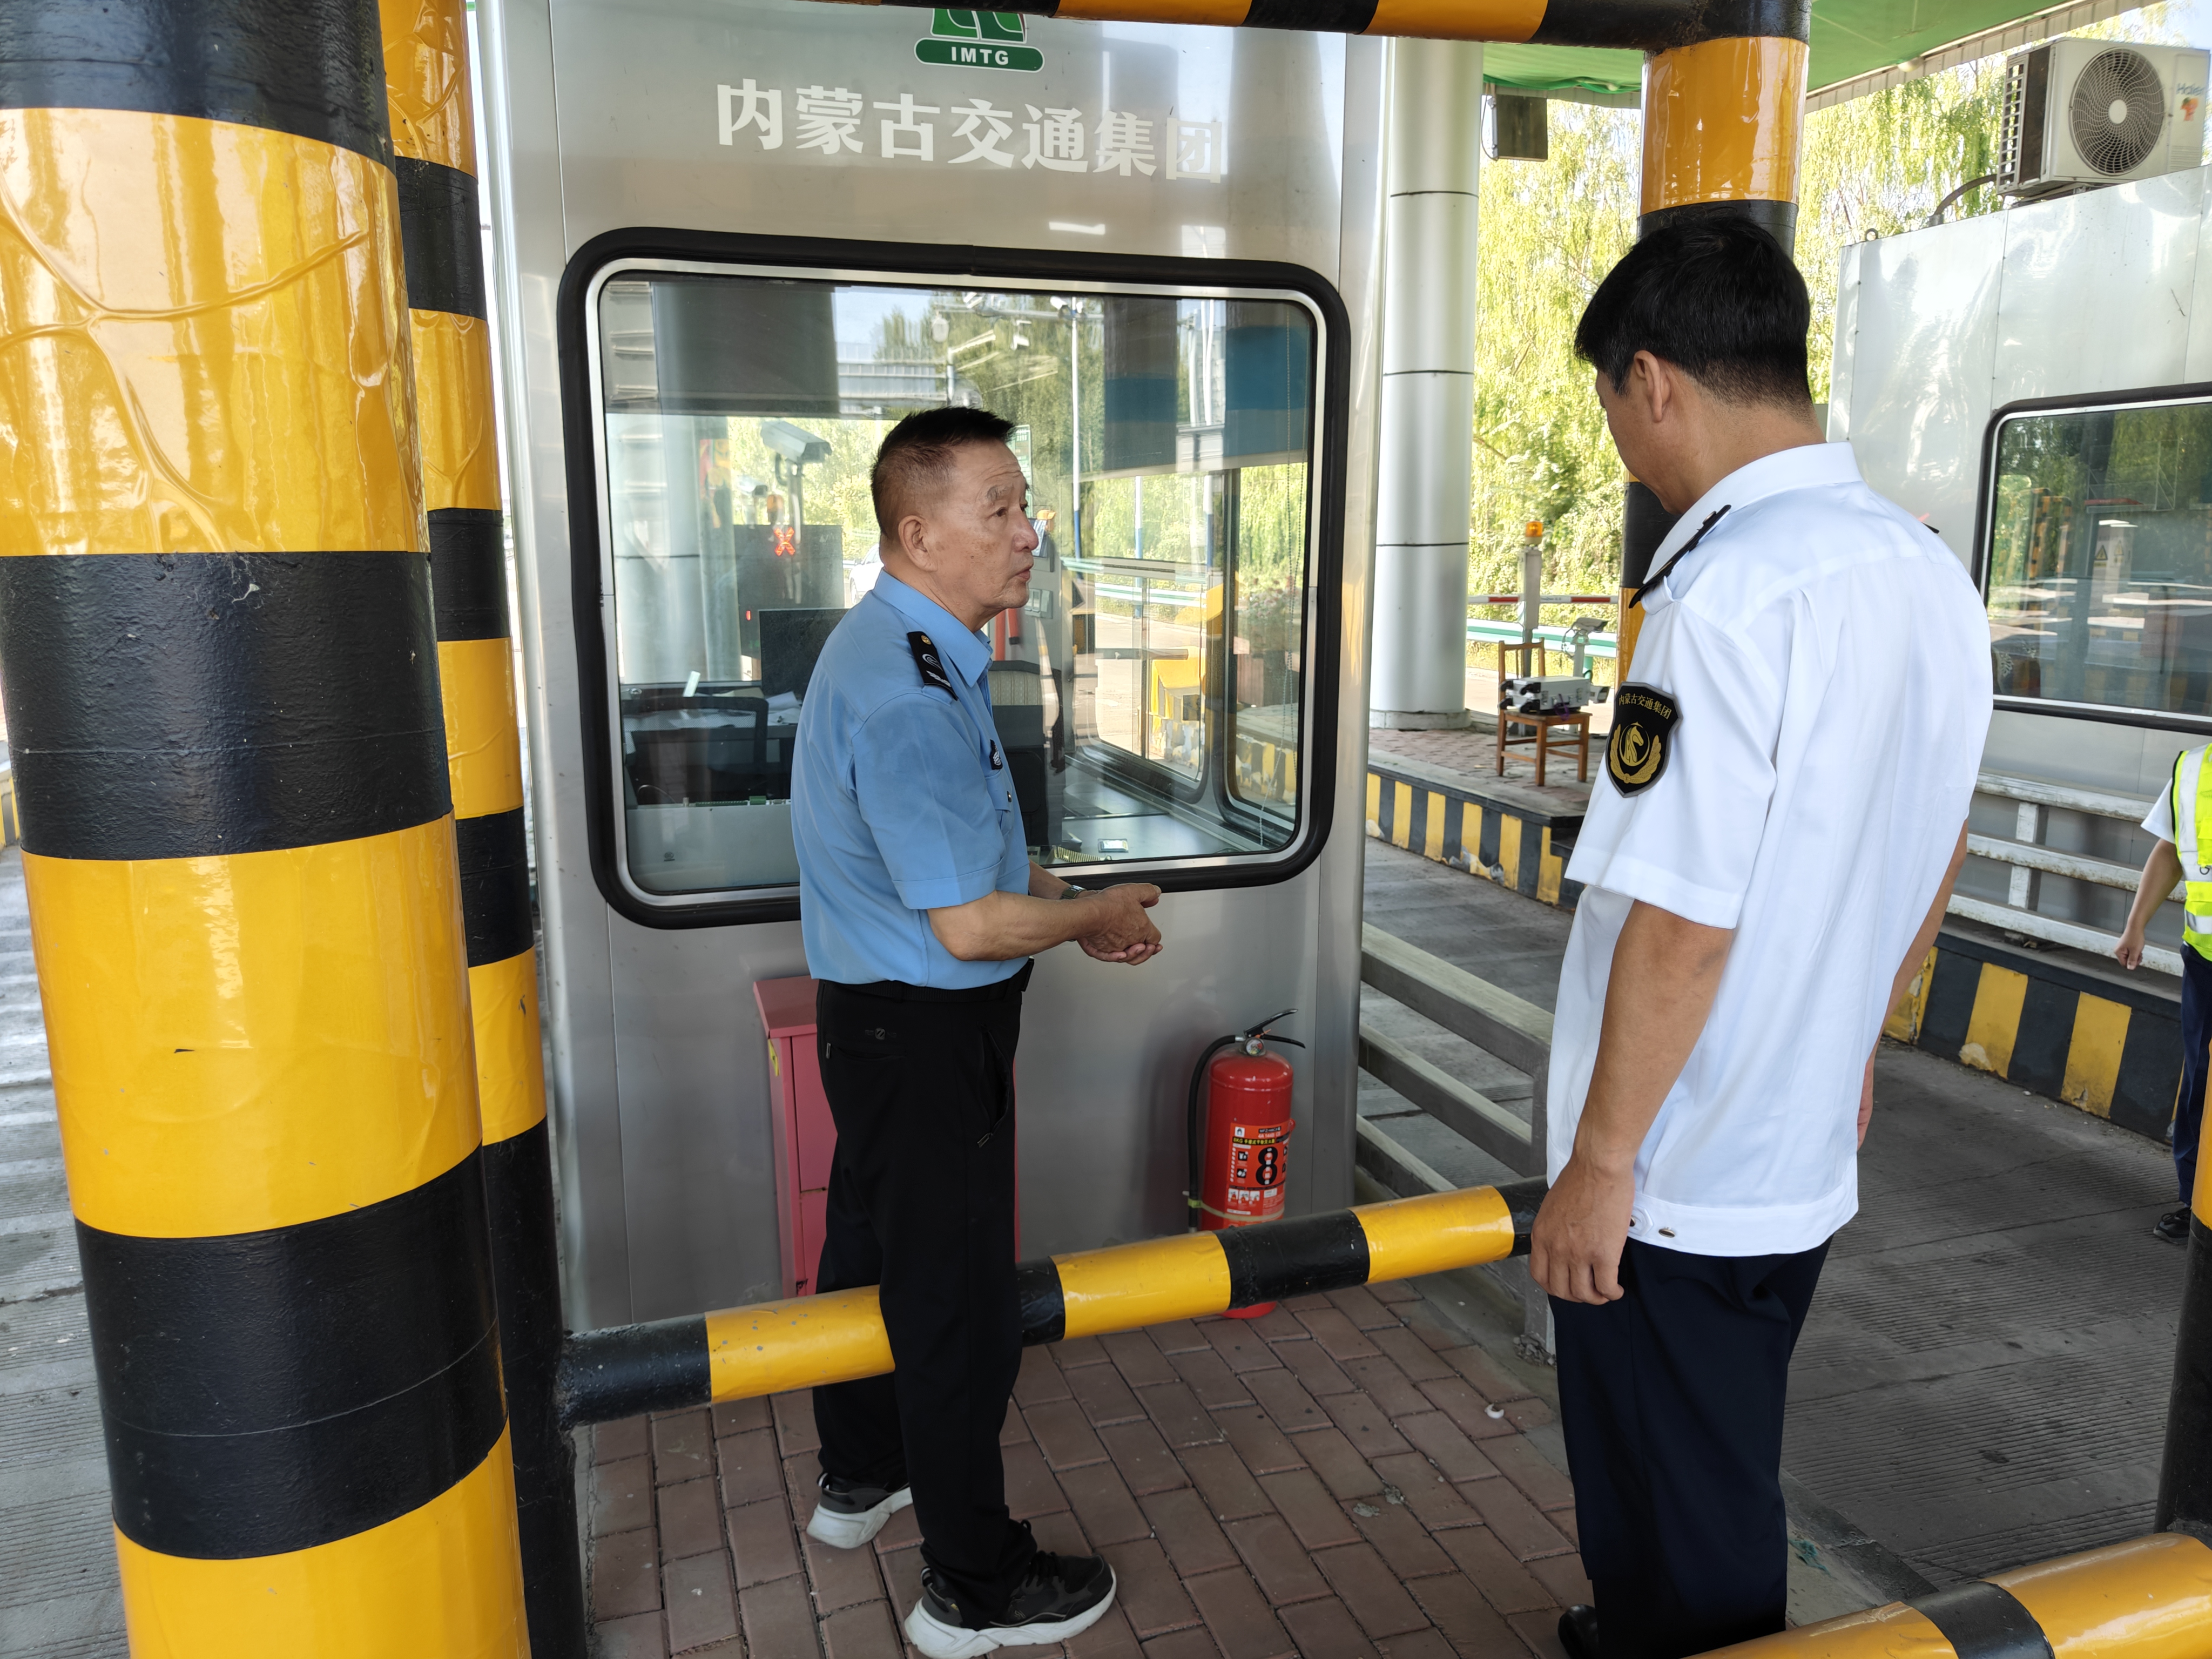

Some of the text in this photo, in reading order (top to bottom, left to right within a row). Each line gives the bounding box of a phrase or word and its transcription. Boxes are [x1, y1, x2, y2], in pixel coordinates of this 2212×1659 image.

[951, 46, 1009, 65] IMTG
[716, 78, 1223, 184] 内蒙古交通集团
[1618, 693, 1672, 719] 内蒙古交通集团
[1256, 1147, 1278, 1185] 8
